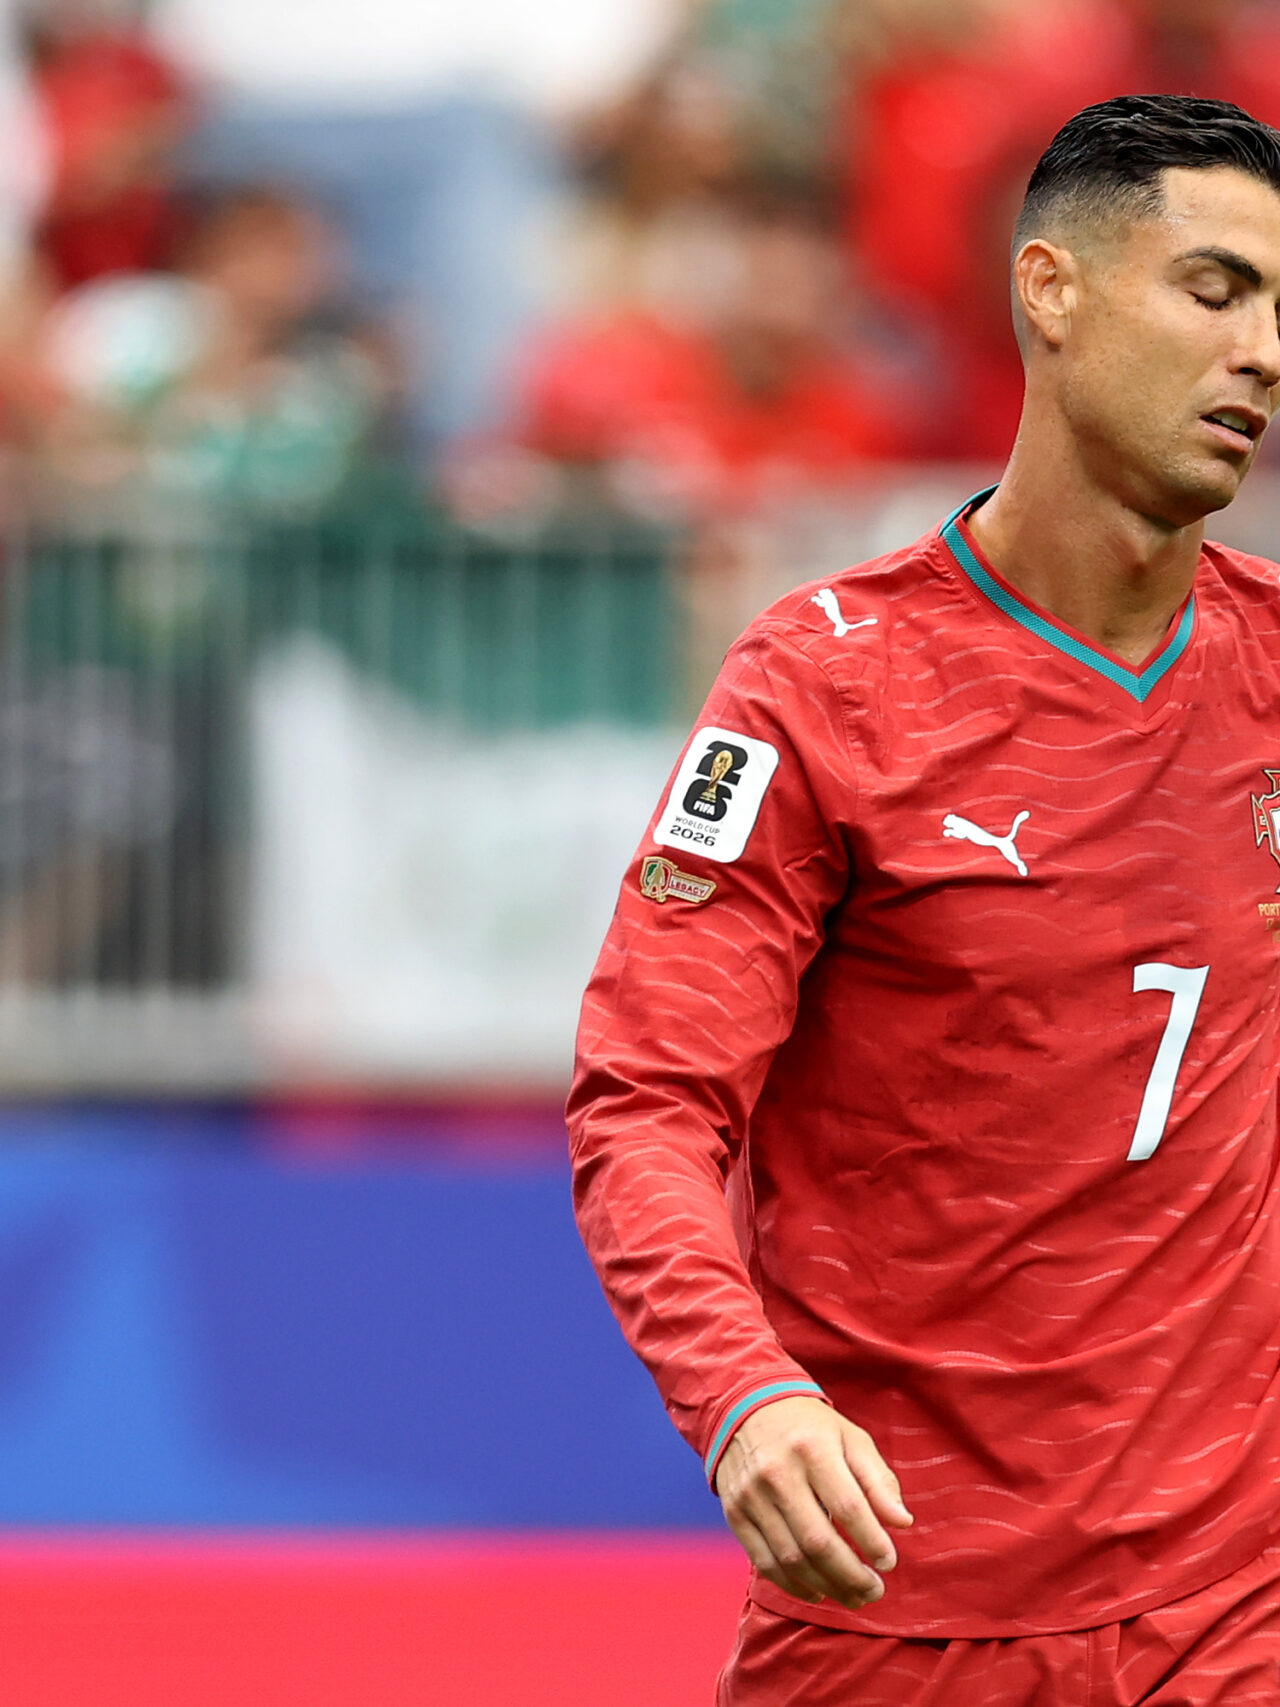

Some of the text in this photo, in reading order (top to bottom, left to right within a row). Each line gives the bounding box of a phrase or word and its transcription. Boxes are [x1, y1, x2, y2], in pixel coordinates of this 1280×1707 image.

[693, 800, 716, 815] FIFA
[675, 816, 721, 834] WORLD CUP
[670, 825, 717, 847] 2026
[671, 880, 706, 894] LEGACY
[1127, 963, 1211, 1161] 7
